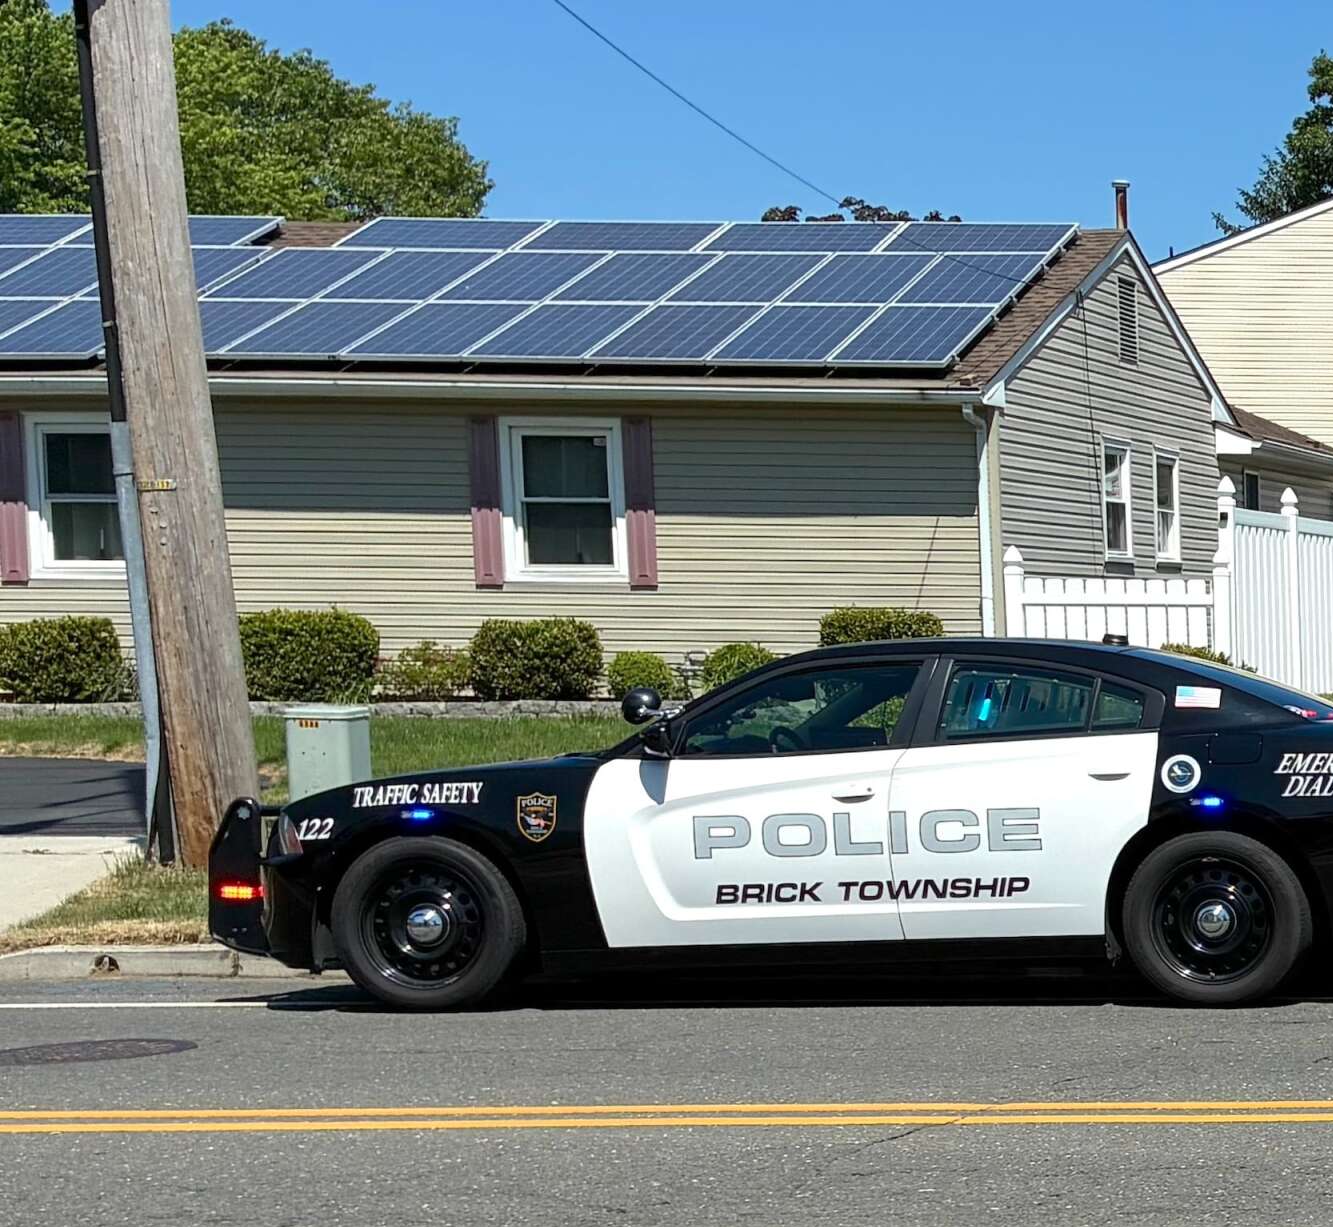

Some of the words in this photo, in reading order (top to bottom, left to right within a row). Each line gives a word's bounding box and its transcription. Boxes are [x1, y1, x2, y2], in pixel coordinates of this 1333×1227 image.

[352, 784, 419, 808] TRAFFIC
[421, 782, 484, 804] SAFETY
[521, 797, 553, 807] POLICE
[298, 818, 335, 841] 122
[693, 807, 1043, 860] POLICE
[715, 882, 825, 905] BRICK
[838, 877, 1031, 902] TOWNSHIP
